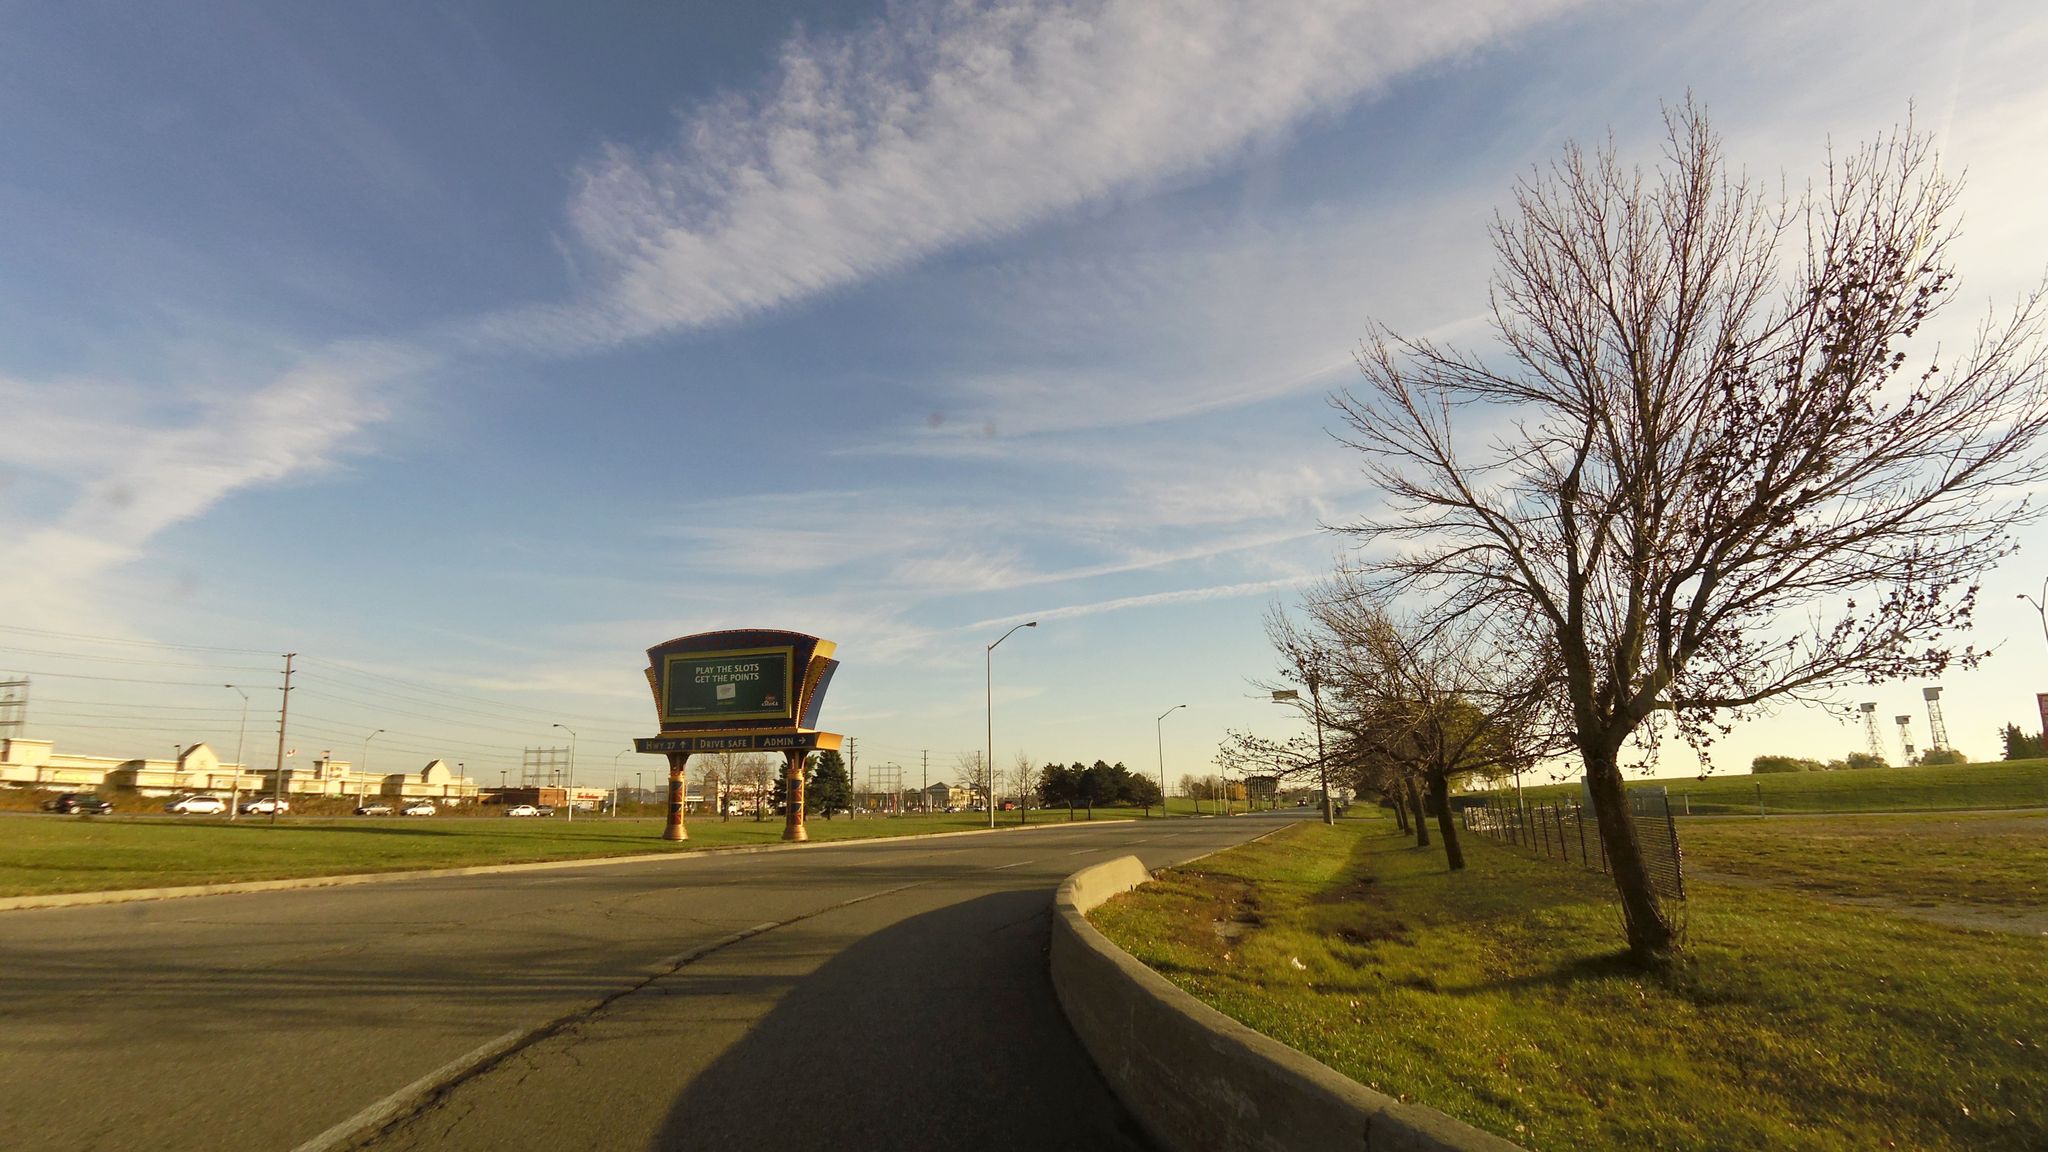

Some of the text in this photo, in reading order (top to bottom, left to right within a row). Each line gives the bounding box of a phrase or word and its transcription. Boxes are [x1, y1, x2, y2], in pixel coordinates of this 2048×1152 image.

[695, 663, 760, 674] PLAY THE SLOTS
[695, 672, 760, 684] GET THE POINTS
[700, 739, 748, 749] DRIVE SAFE
[764, 737, 794, 747] ADMIN
